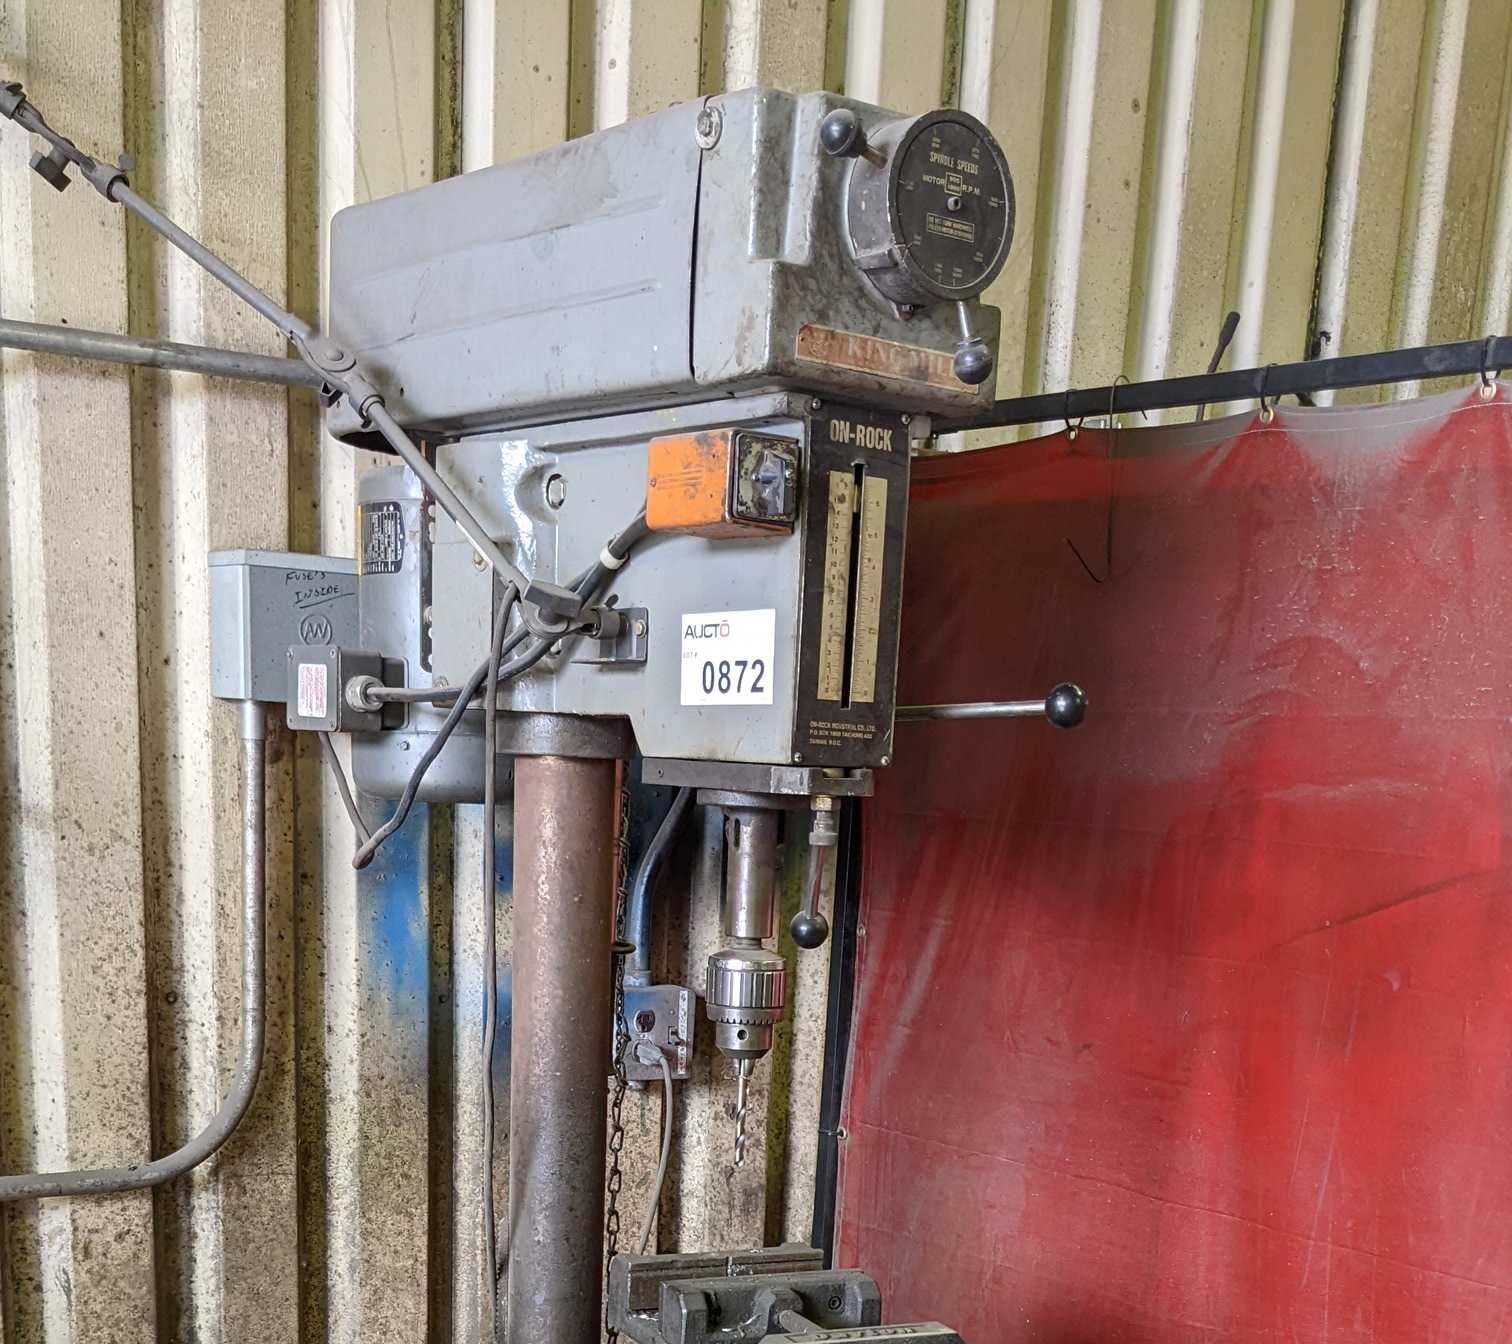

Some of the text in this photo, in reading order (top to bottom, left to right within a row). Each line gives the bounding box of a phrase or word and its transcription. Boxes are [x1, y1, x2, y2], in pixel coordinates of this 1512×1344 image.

[929, 151, 955, 167] SPINDLE
[957, 160, 979, 176] SPEEDS
[922, 174, 945, 185] MOTOR
[829, 420, 893, 452] ON-ROCK
[295, 585, 340, 604] INSIDE
[702, 659, 765, 694] 0872
